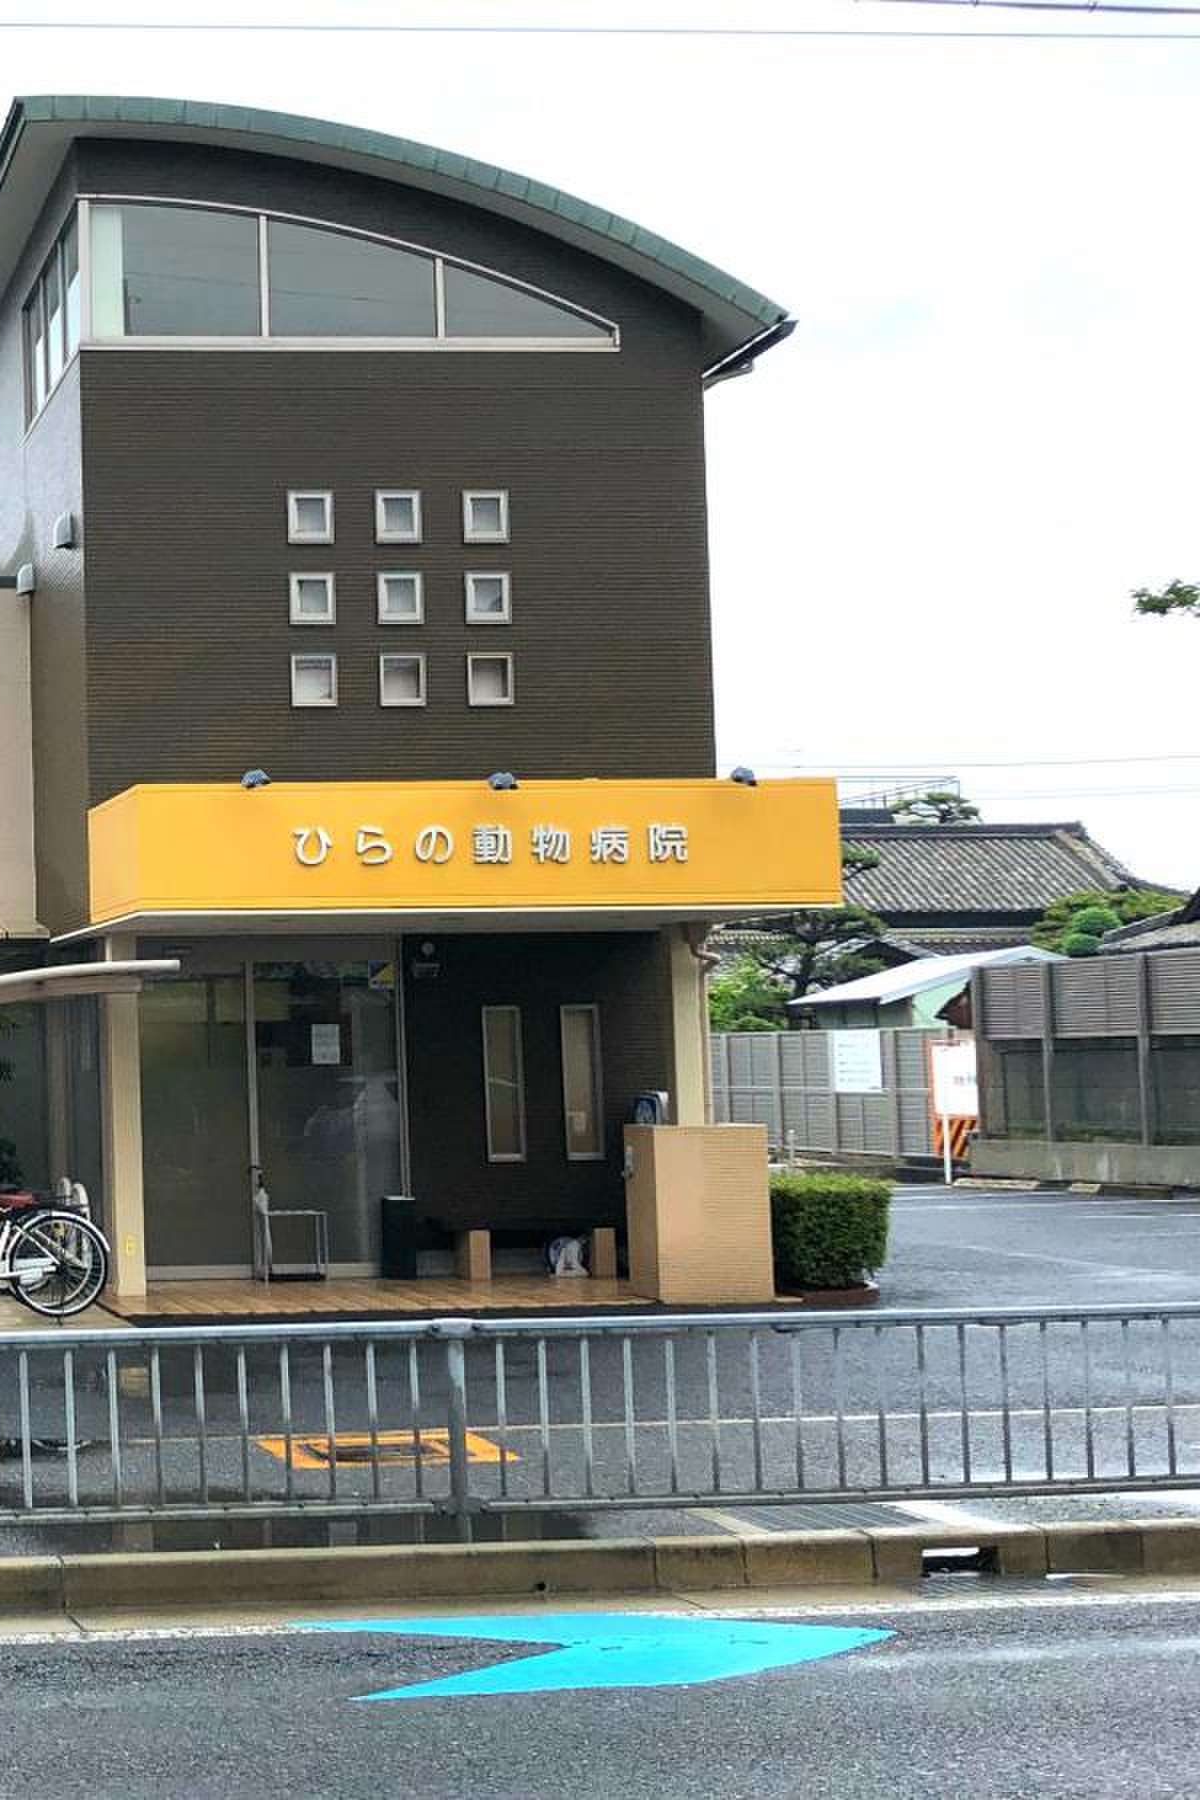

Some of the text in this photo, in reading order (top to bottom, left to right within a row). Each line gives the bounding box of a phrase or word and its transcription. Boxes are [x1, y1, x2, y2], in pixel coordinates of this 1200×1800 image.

[292, 823, 689, 865] ひらの動物病院
